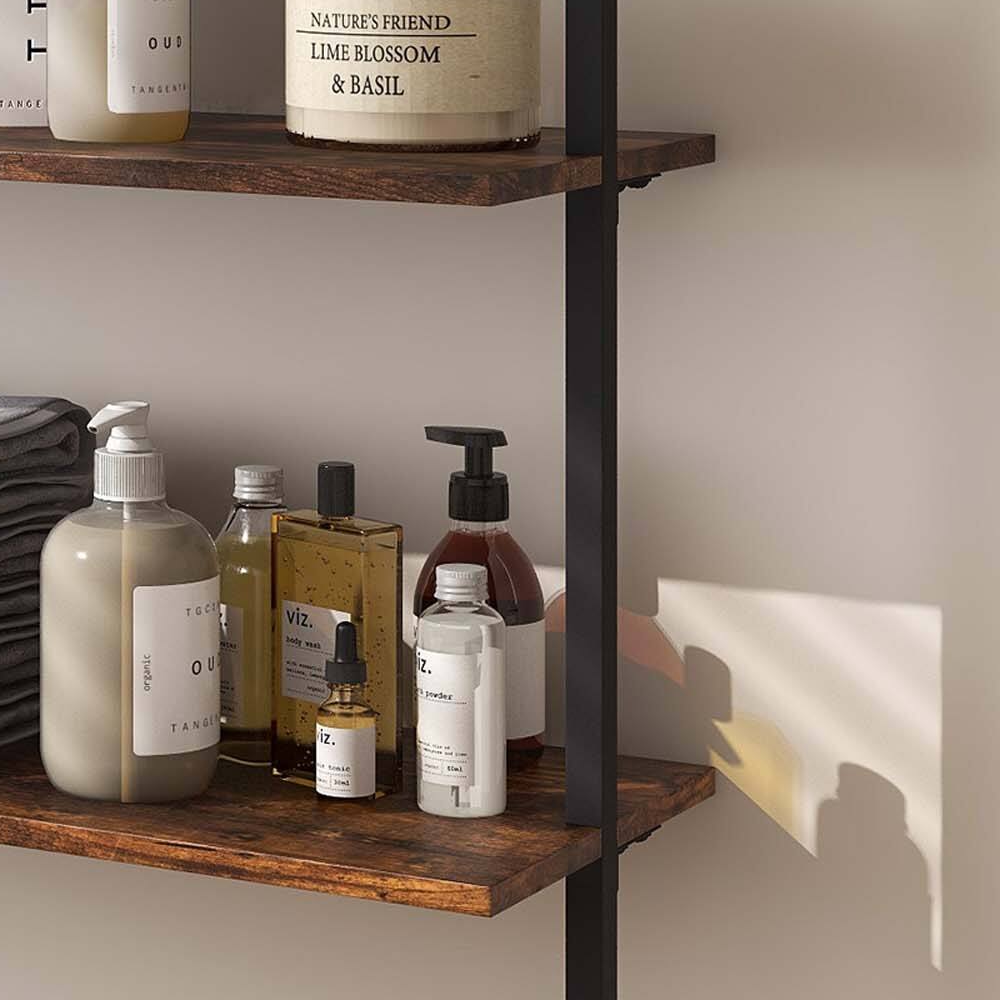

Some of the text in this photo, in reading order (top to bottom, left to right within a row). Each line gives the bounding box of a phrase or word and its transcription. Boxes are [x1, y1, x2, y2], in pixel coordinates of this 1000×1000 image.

[311, 12, 451, 31] NATURE'S FRIEND
[148, 35, 182, 50] OUD
[311, 42, 440, 63] LIME BLOSSOM
[332, 73, 404, 96] & BASIL
[286, 607, 313, 628] viz.
[143, 654, 153, 692] organic
[417, 653, 432, 674] iz.
[425, 690, 454, 701] powder
